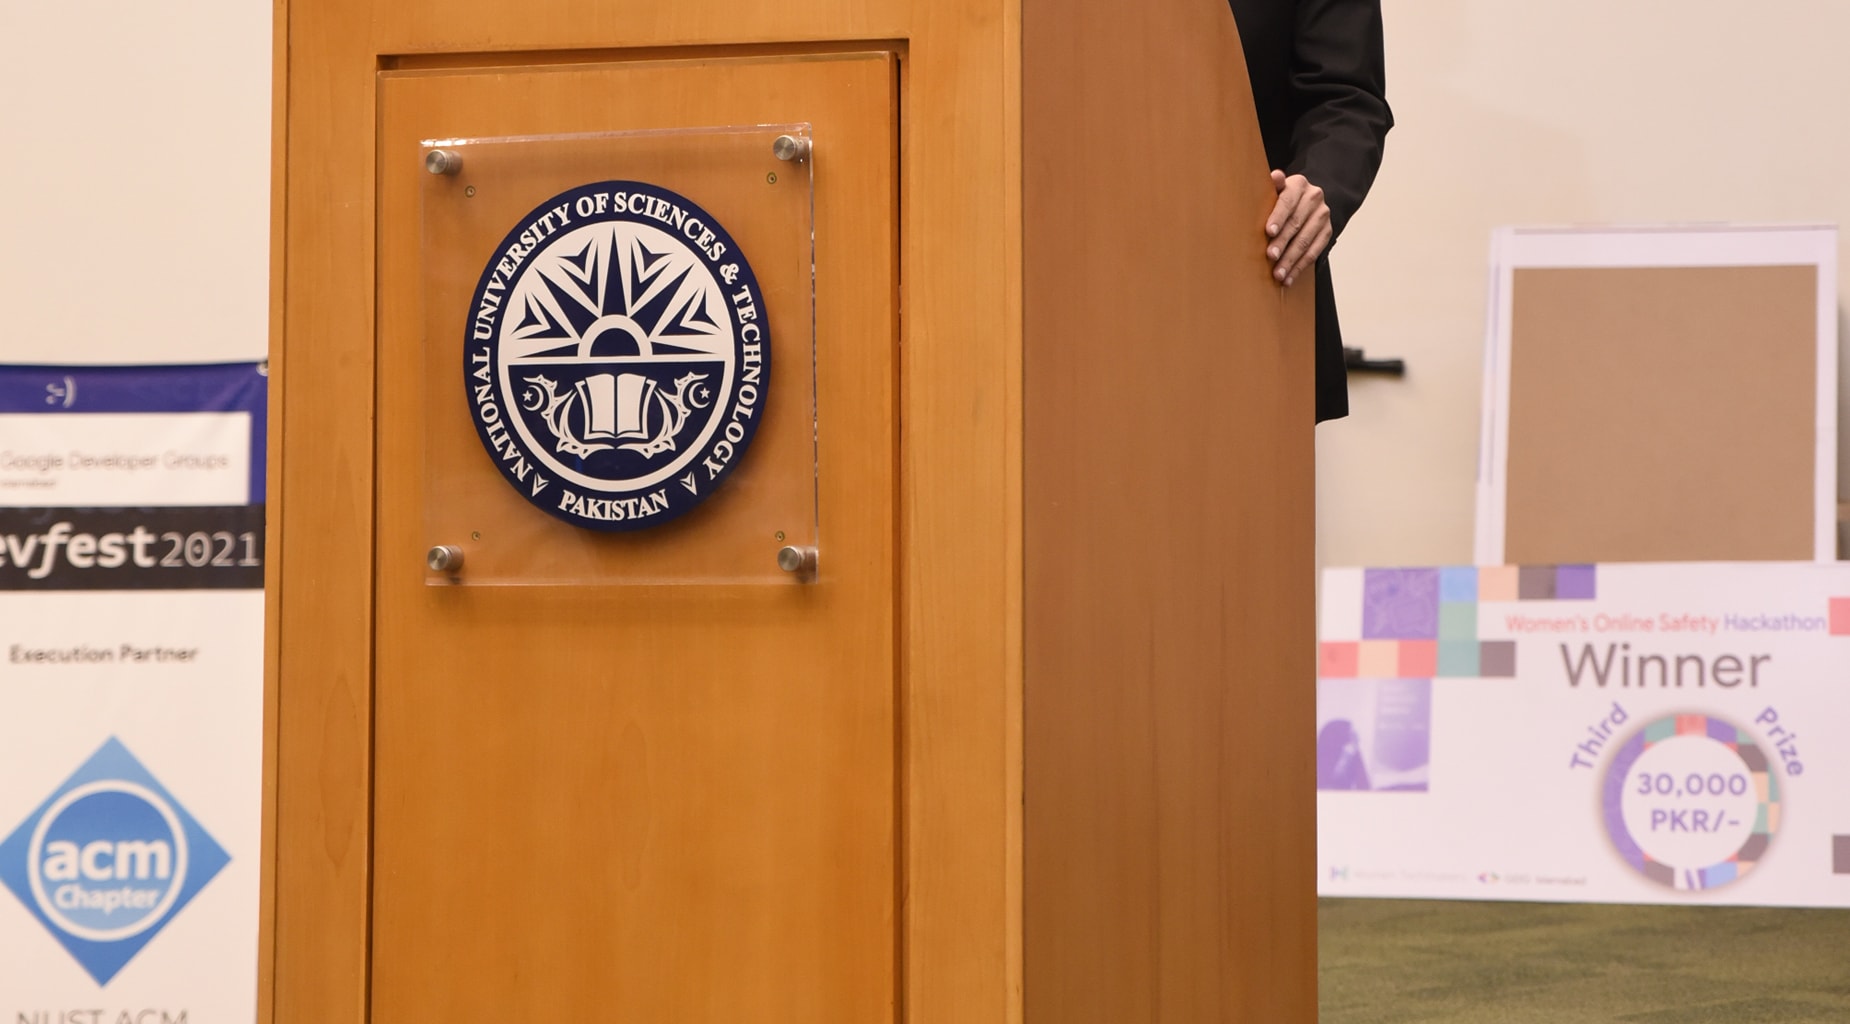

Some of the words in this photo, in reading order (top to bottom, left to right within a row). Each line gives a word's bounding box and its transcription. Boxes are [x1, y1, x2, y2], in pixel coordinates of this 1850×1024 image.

[576, 193, 609, 217] OF
[614, 192, 726, 261] SCIENCES
[473, 202, 571, 340] UNIVERSITY
[719, 263, 740, 285] &
[703, 285, 762, 480] TECHNOLOGY
[472, 347, 533, 482] NATIONAL
[558, 489, 669, 521] PAKISTAN
[1505, 613, 1589, 633] Women's
[1593, 613, 1656, 633] Online
[1659, 613, 1721, 635] Safety
[1723, 613, 1827, 632] Hackathon
[9, 643, 114, 664] Execution
[119, 643, 200, 663] Partner
[1559, 642, 1772, 688] Winner
[1569, 701, 1629, 770] Third
[1755, 706, 1804, 777] Prize
[1636, 772, 1748, 799] 30,000
[1650, 809, 1740, 833] PKR/-
[43, 838, 172, 881] acm
[54, 884, 161, 915] Chapter
